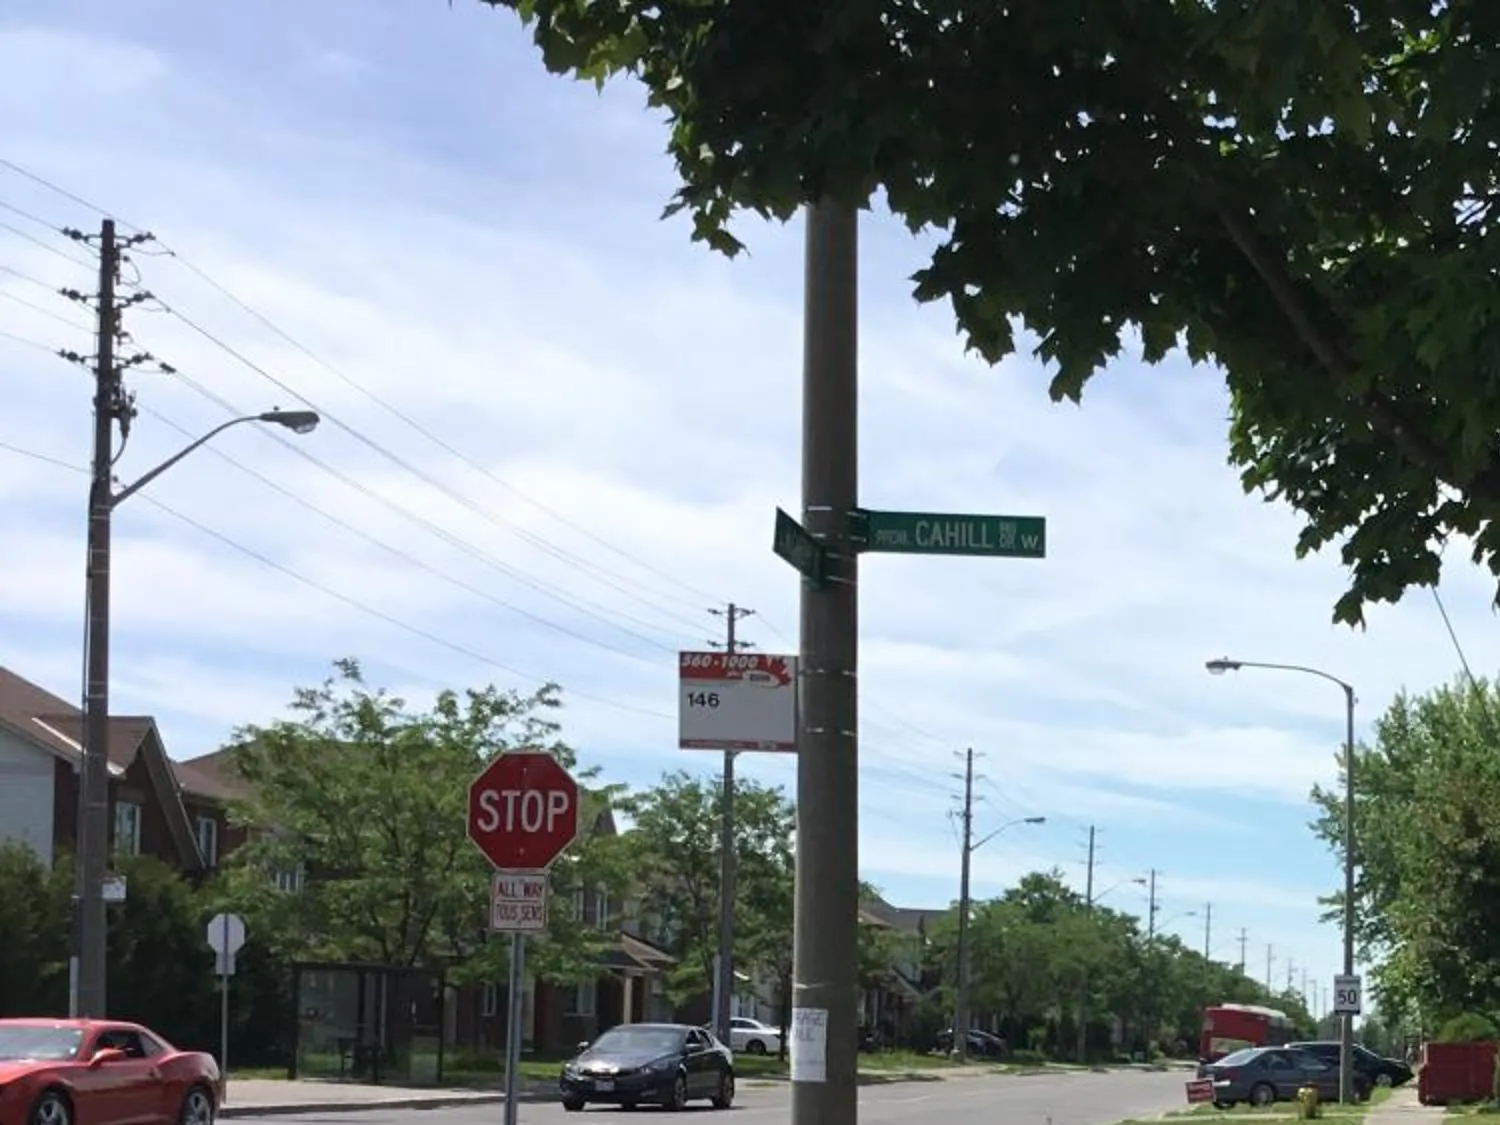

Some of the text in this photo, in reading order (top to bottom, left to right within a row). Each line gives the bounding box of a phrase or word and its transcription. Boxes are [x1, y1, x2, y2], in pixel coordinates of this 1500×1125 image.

[915, 520, 994, 549] CAHILL
[687, 692, 721, 708] 146
[477, 789, 569, 833] STOP
[498, 881, 544, 897] ALL WAY
[1337, 989, 1357, 1005] 50
